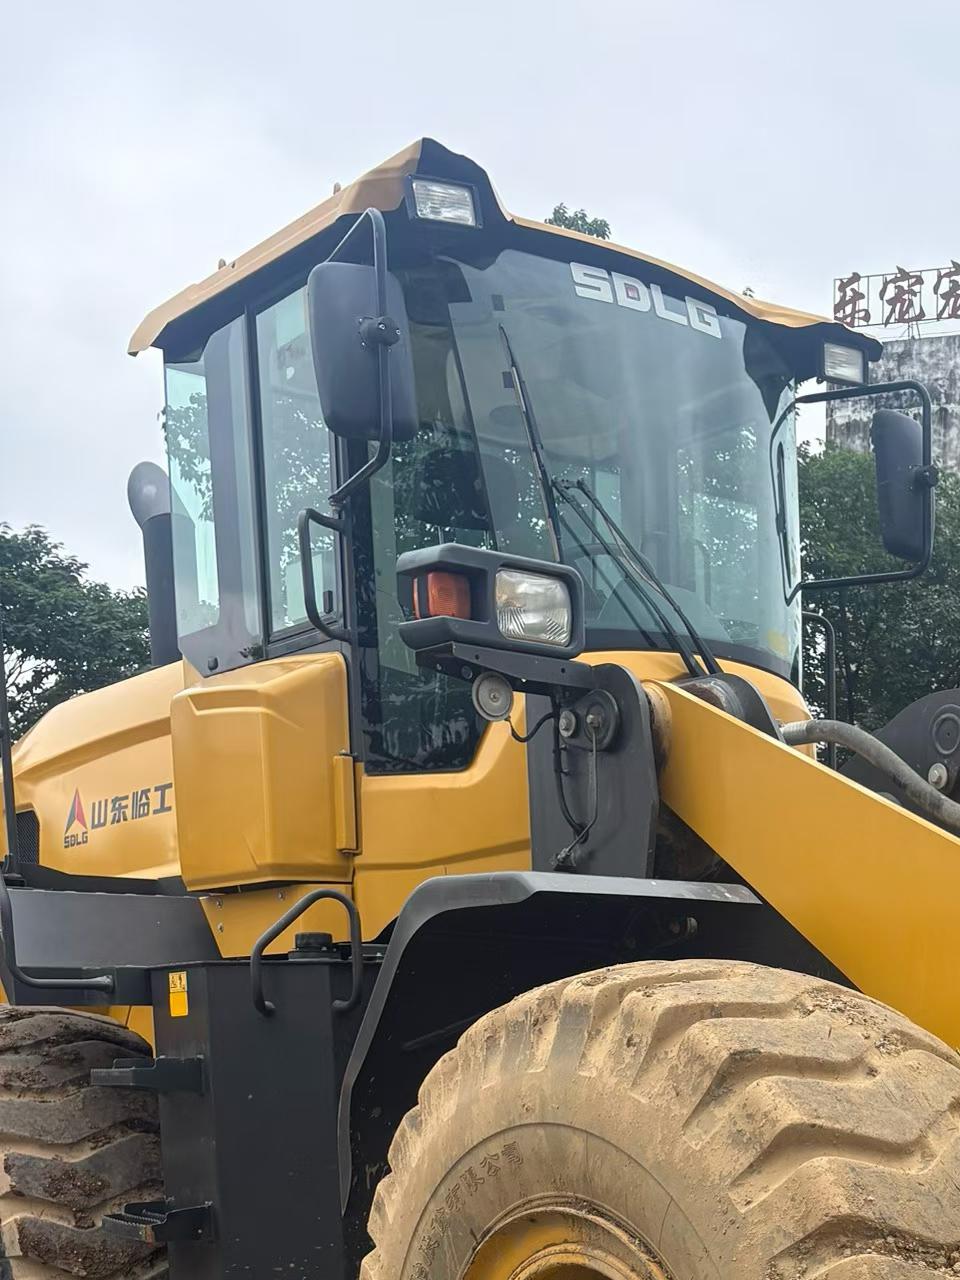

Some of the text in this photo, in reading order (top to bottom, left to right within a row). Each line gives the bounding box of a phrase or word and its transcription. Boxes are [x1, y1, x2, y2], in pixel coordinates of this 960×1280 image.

[569, 261, 722, 340] SDLG
[91, 782, 173, 830] 山东临工
[63, 831, 88, 849] SDLG
